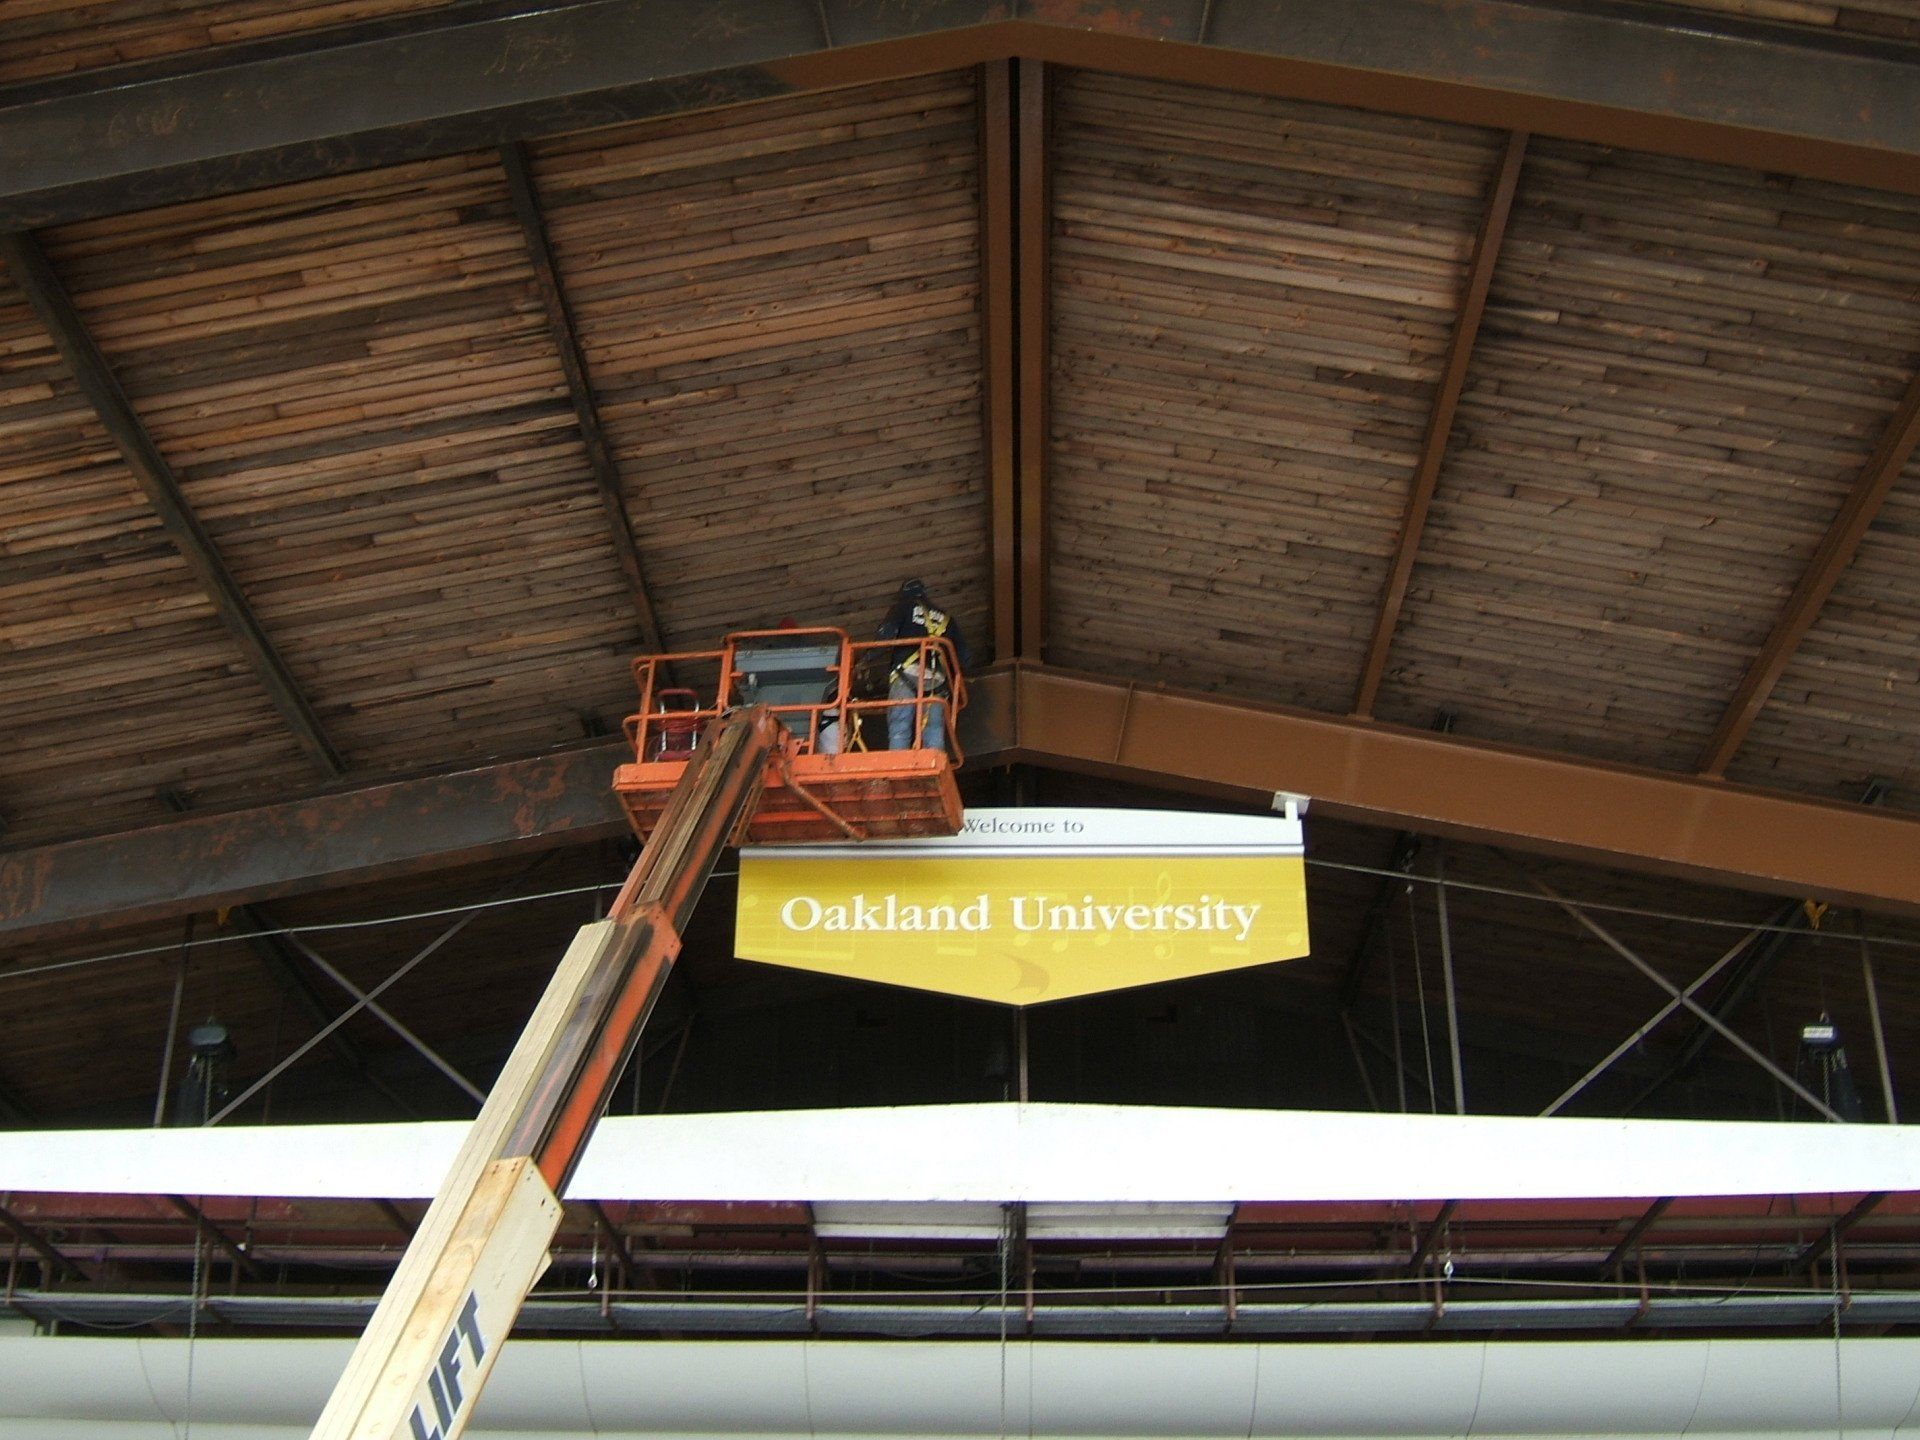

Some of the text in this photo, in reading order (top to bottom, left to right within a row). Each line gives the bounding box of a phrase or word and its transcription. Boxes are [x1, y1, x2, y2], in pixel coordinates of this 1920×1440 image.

[963, 816, 1085, 835] Welcome to
[780, 893, 1260, 941] Oakland University
[409, 1290, 486, 1440] LIFT
